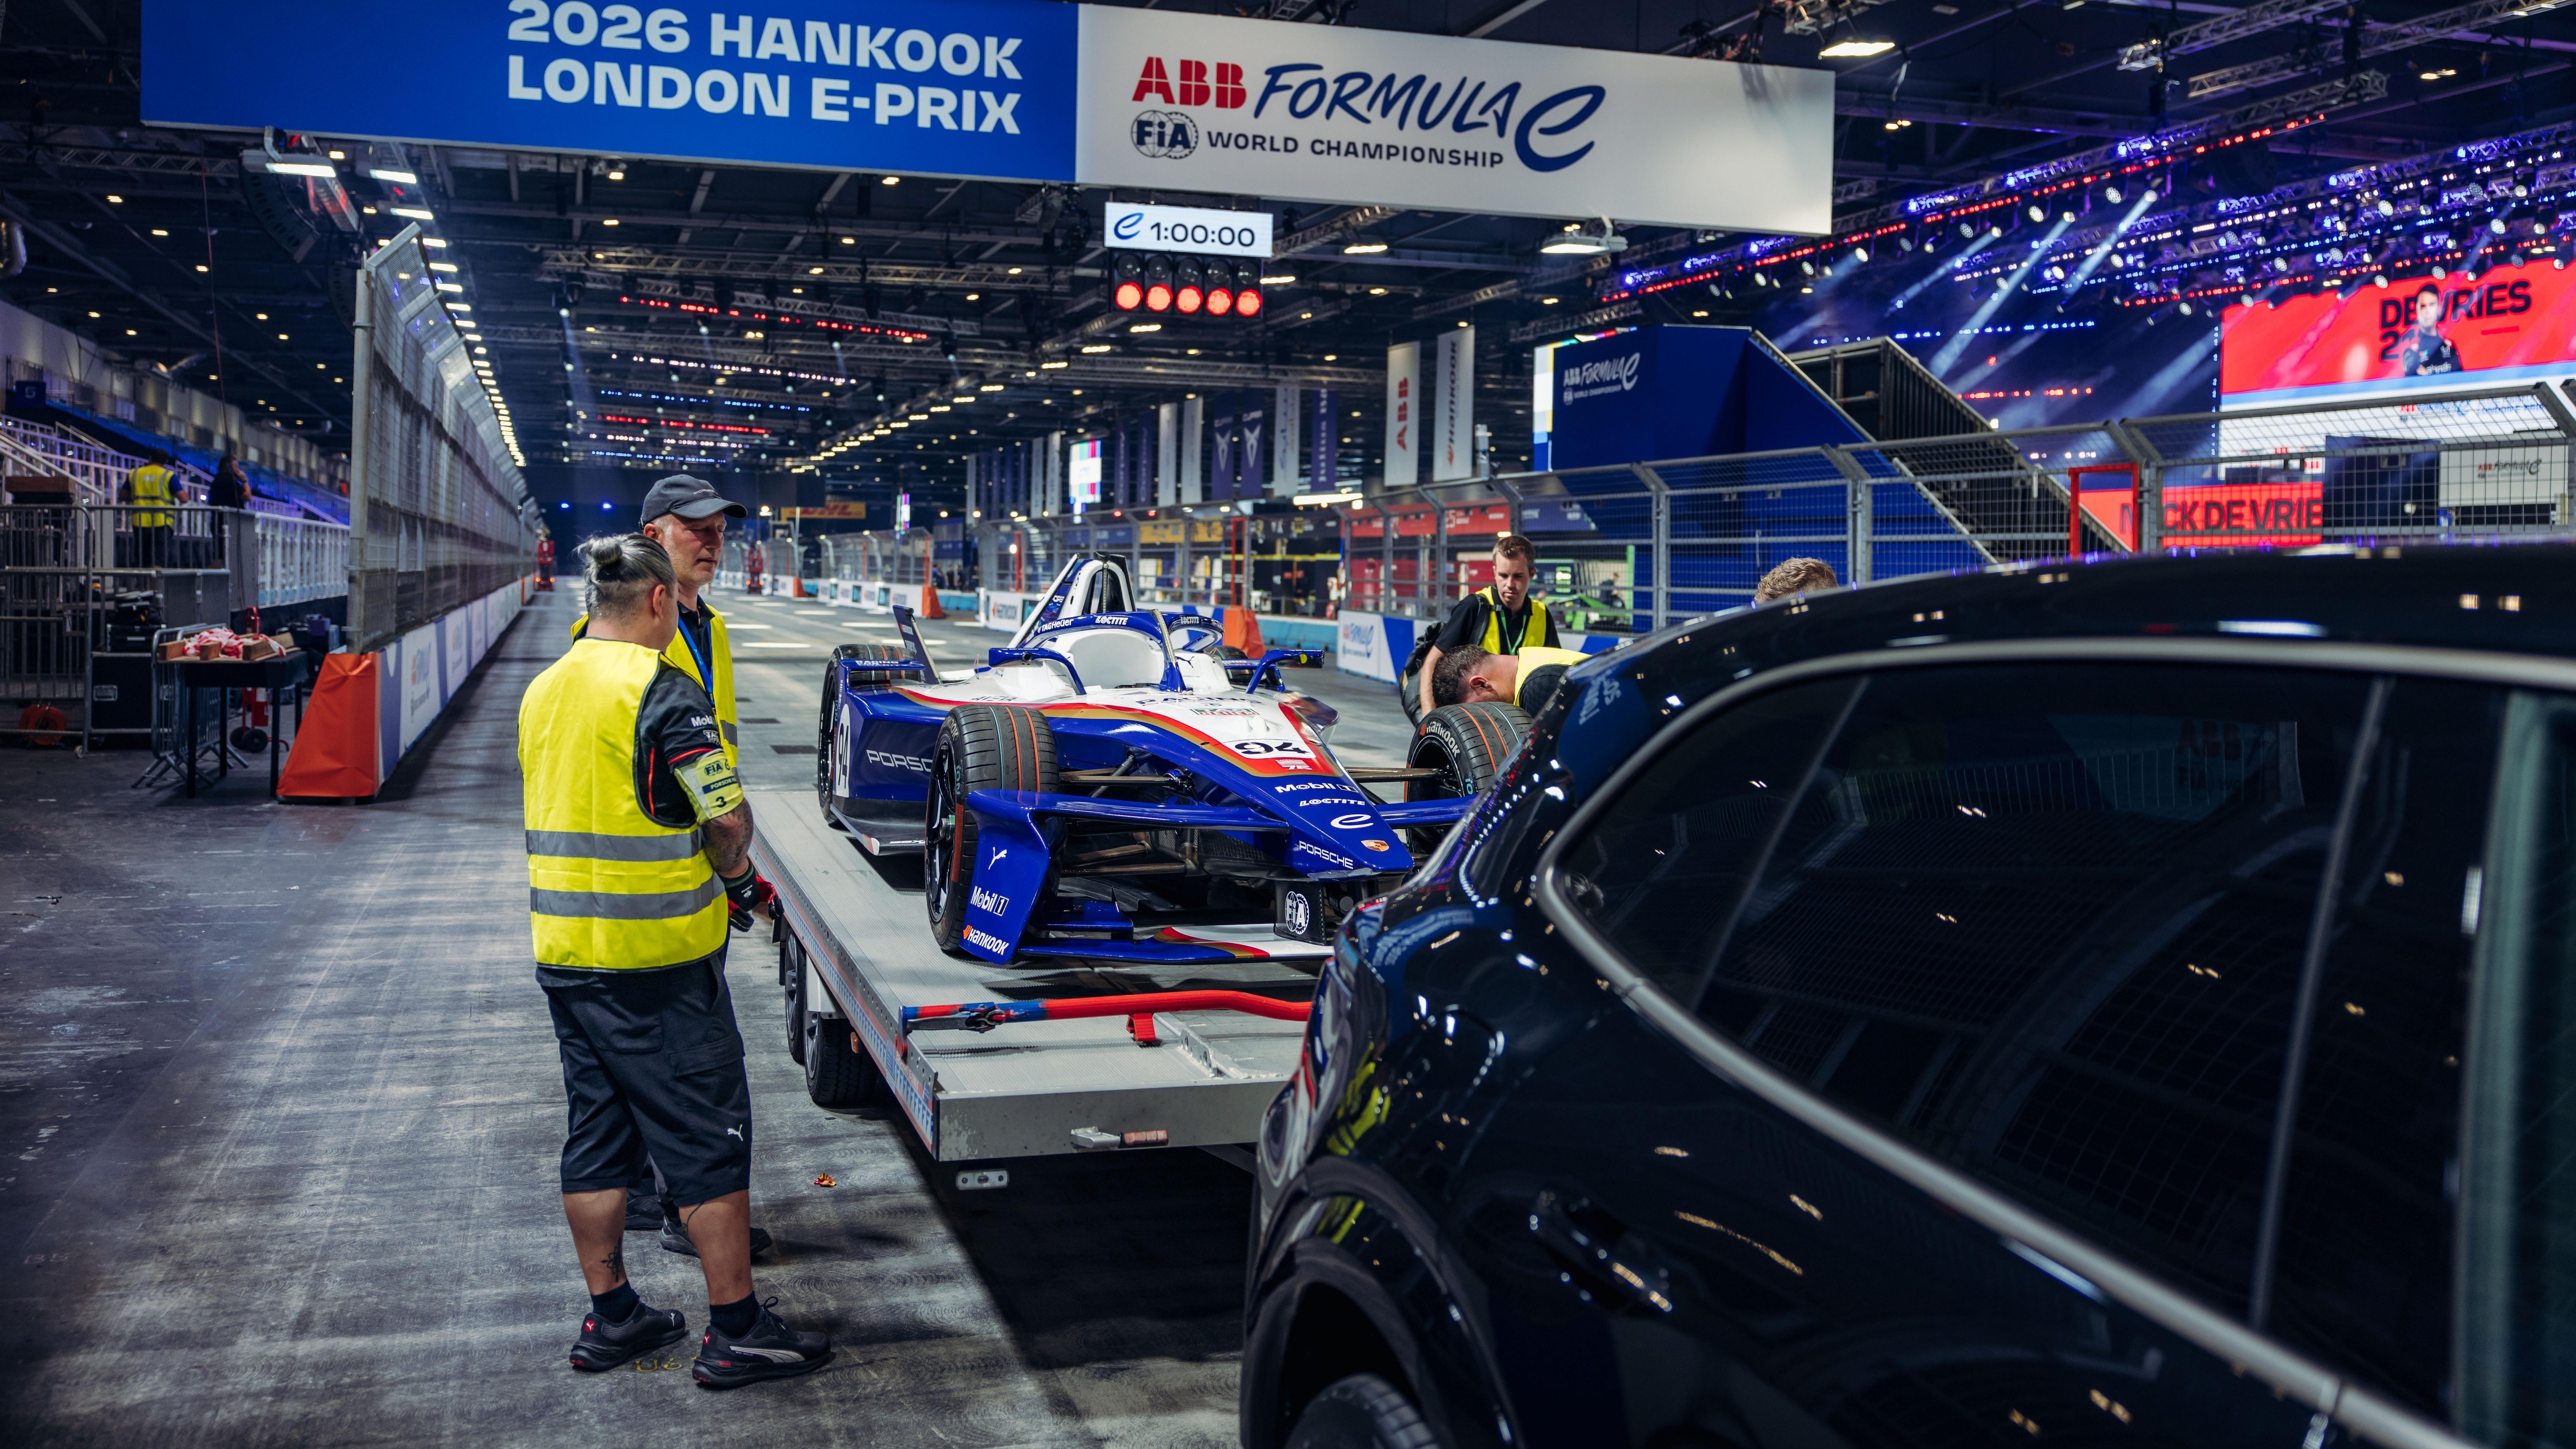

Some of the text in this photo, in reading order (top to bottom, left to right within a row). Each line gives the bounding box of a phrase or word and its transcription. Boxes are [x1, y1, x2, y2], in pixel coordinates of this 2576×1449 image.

[508, 0, 1022, 80] 2026 HANKOOK
[508, 55, 1021, 134] LONDON E-PRIX
[1132, 57, 1247, 109] ABB
[1254, 63, 1522, 139] FORMULA
[1208, 131, 1299, 153] WORLD
[1310, 139, 1504, 168] CHAMPIONSHIP
[1150, 221, 1255, 248] 1:00:00
[1397, 377, 1408, 451] ABB
[2205, 501, 2245, 530] DE
[1095, 615, 1129, 626] LOCTITE
[838, 723, 849, 789] 94
[1235, 742, 1310, 754] 94
[716, 796, 727, 808] 3
[1275, 782, 1336, 793] Mobil
[1300, 798, 1365, 807] LOCTITE
[1299, 840, 1353, 870] PORSCHE
[970, 886, 997, 912] Mobil
